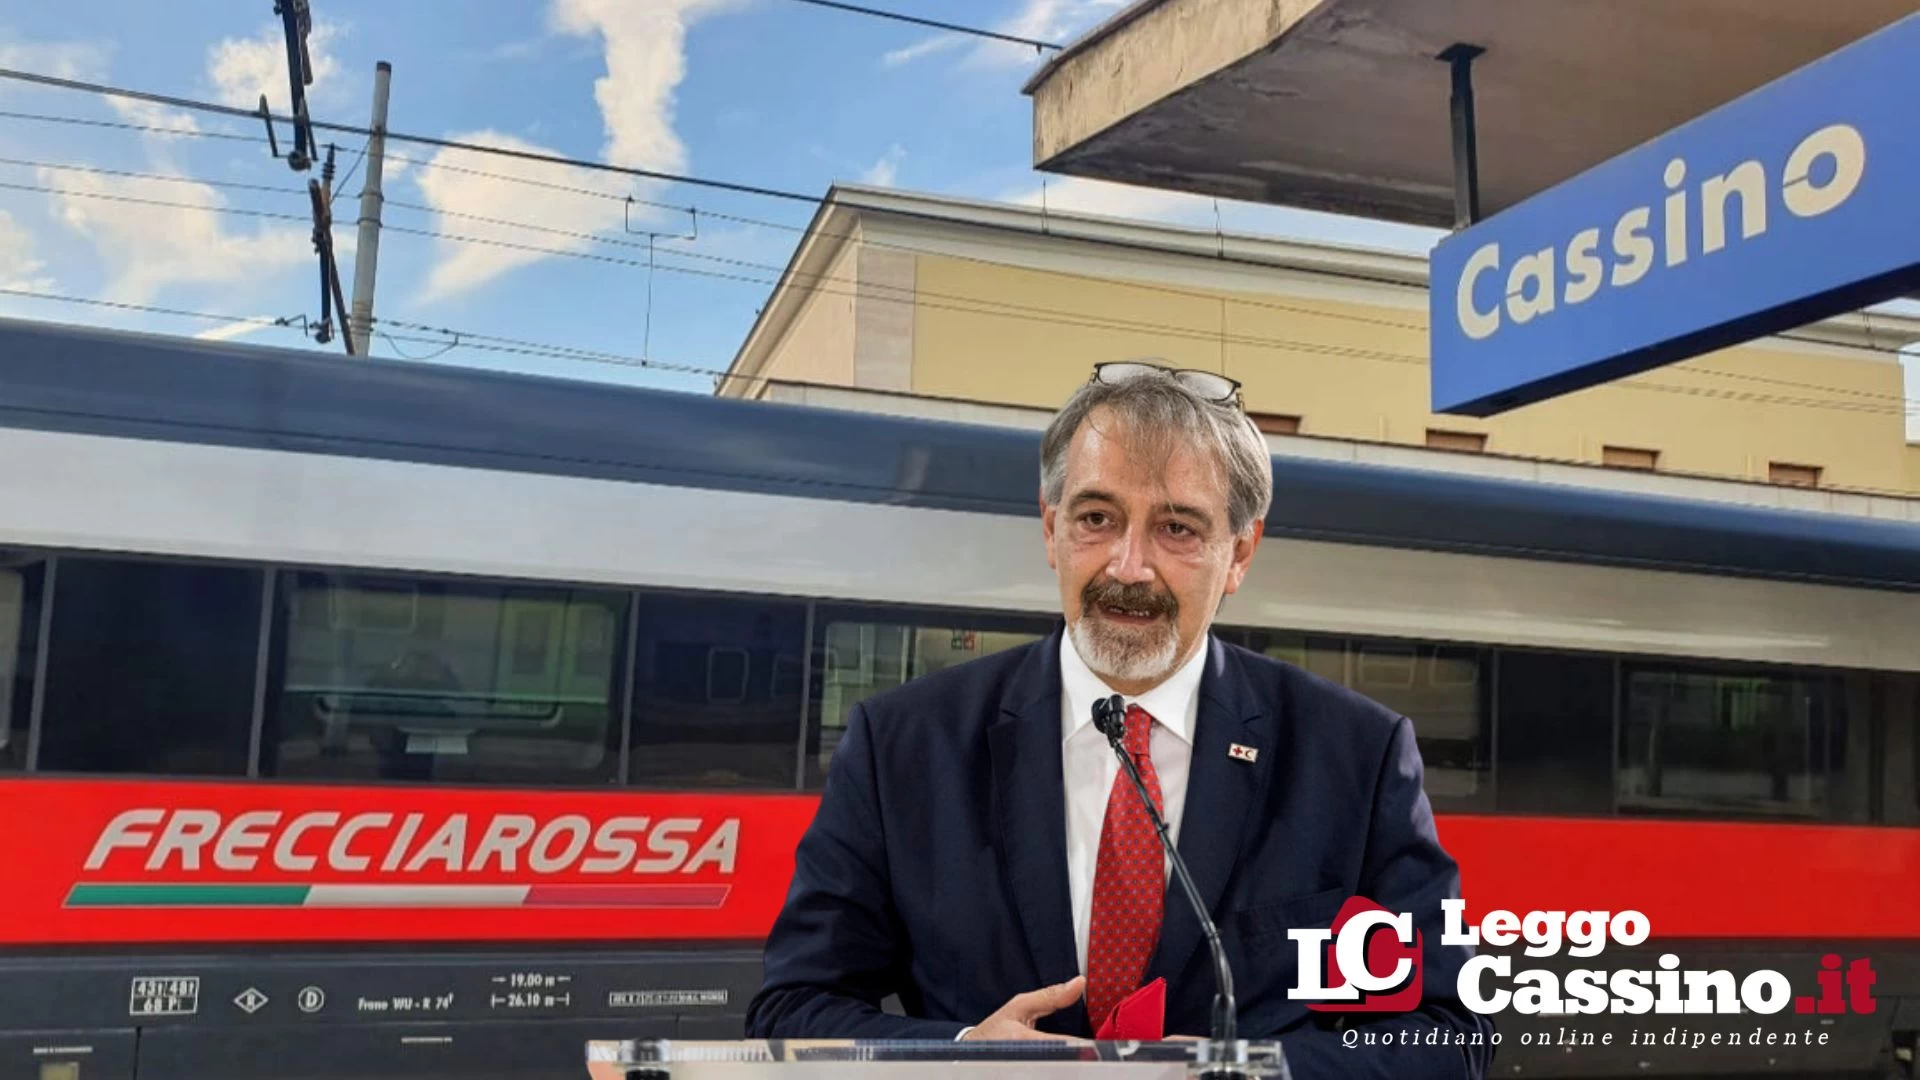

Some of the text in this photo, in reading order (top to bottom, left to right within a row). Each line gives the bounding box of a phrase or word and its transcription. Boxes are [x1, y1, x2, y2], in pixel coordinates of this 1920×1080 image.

[1456, 123, 1865, 339] Cassino
[83, 809, 740, 874] FRECCIAROSSA
[306, 991, 318, 1008] D
